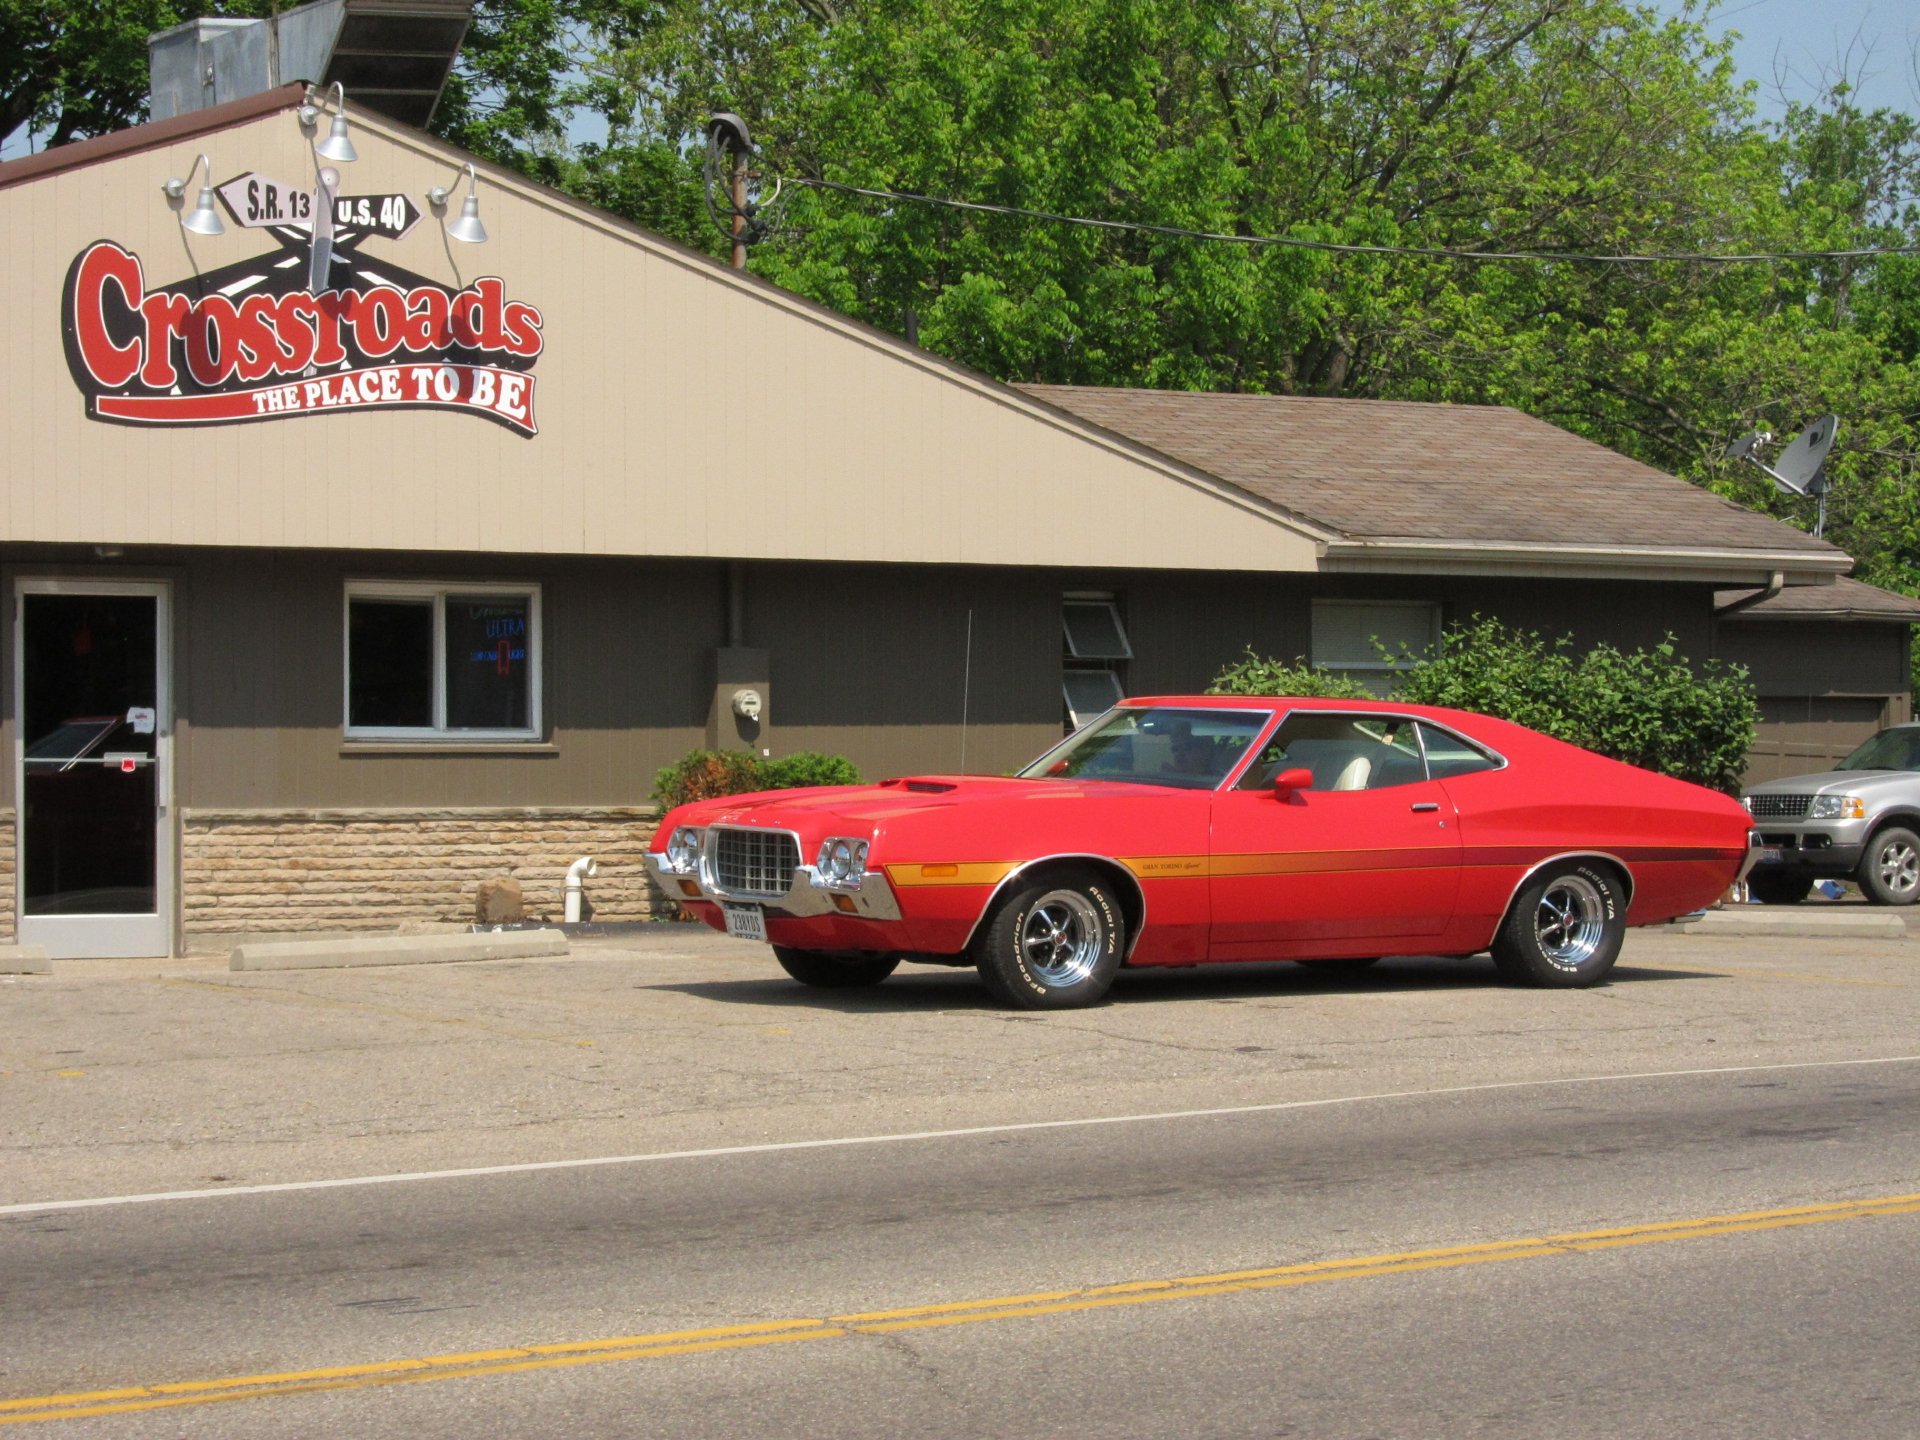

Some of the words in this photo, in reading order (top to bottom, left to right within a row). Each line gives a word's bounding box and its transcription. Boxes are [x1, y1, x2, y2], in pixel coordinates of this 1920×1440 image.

[247, 179, 283, 221] S.R.
[289, 190, 310, 218] 13
[338, 198, 376, 226] U.S.
[380, 195, 406, 231] 40
[74, 242, 544, 388] Crossroads
[252, 386, 300, 413] THE
[304, 368, 402, 406] PLACE
[411, 367, 460, 401] TO
[469, 369, 527, 420] BE
[1089, 886, 1115, 928] Radial
[1107, 931, 1115, 954] T/A
[1577, 866, 1611, 895] Radial
[1606, 898, 1615, 920] T/A
[1013, 912, 1047, 995] BFGoodrich
